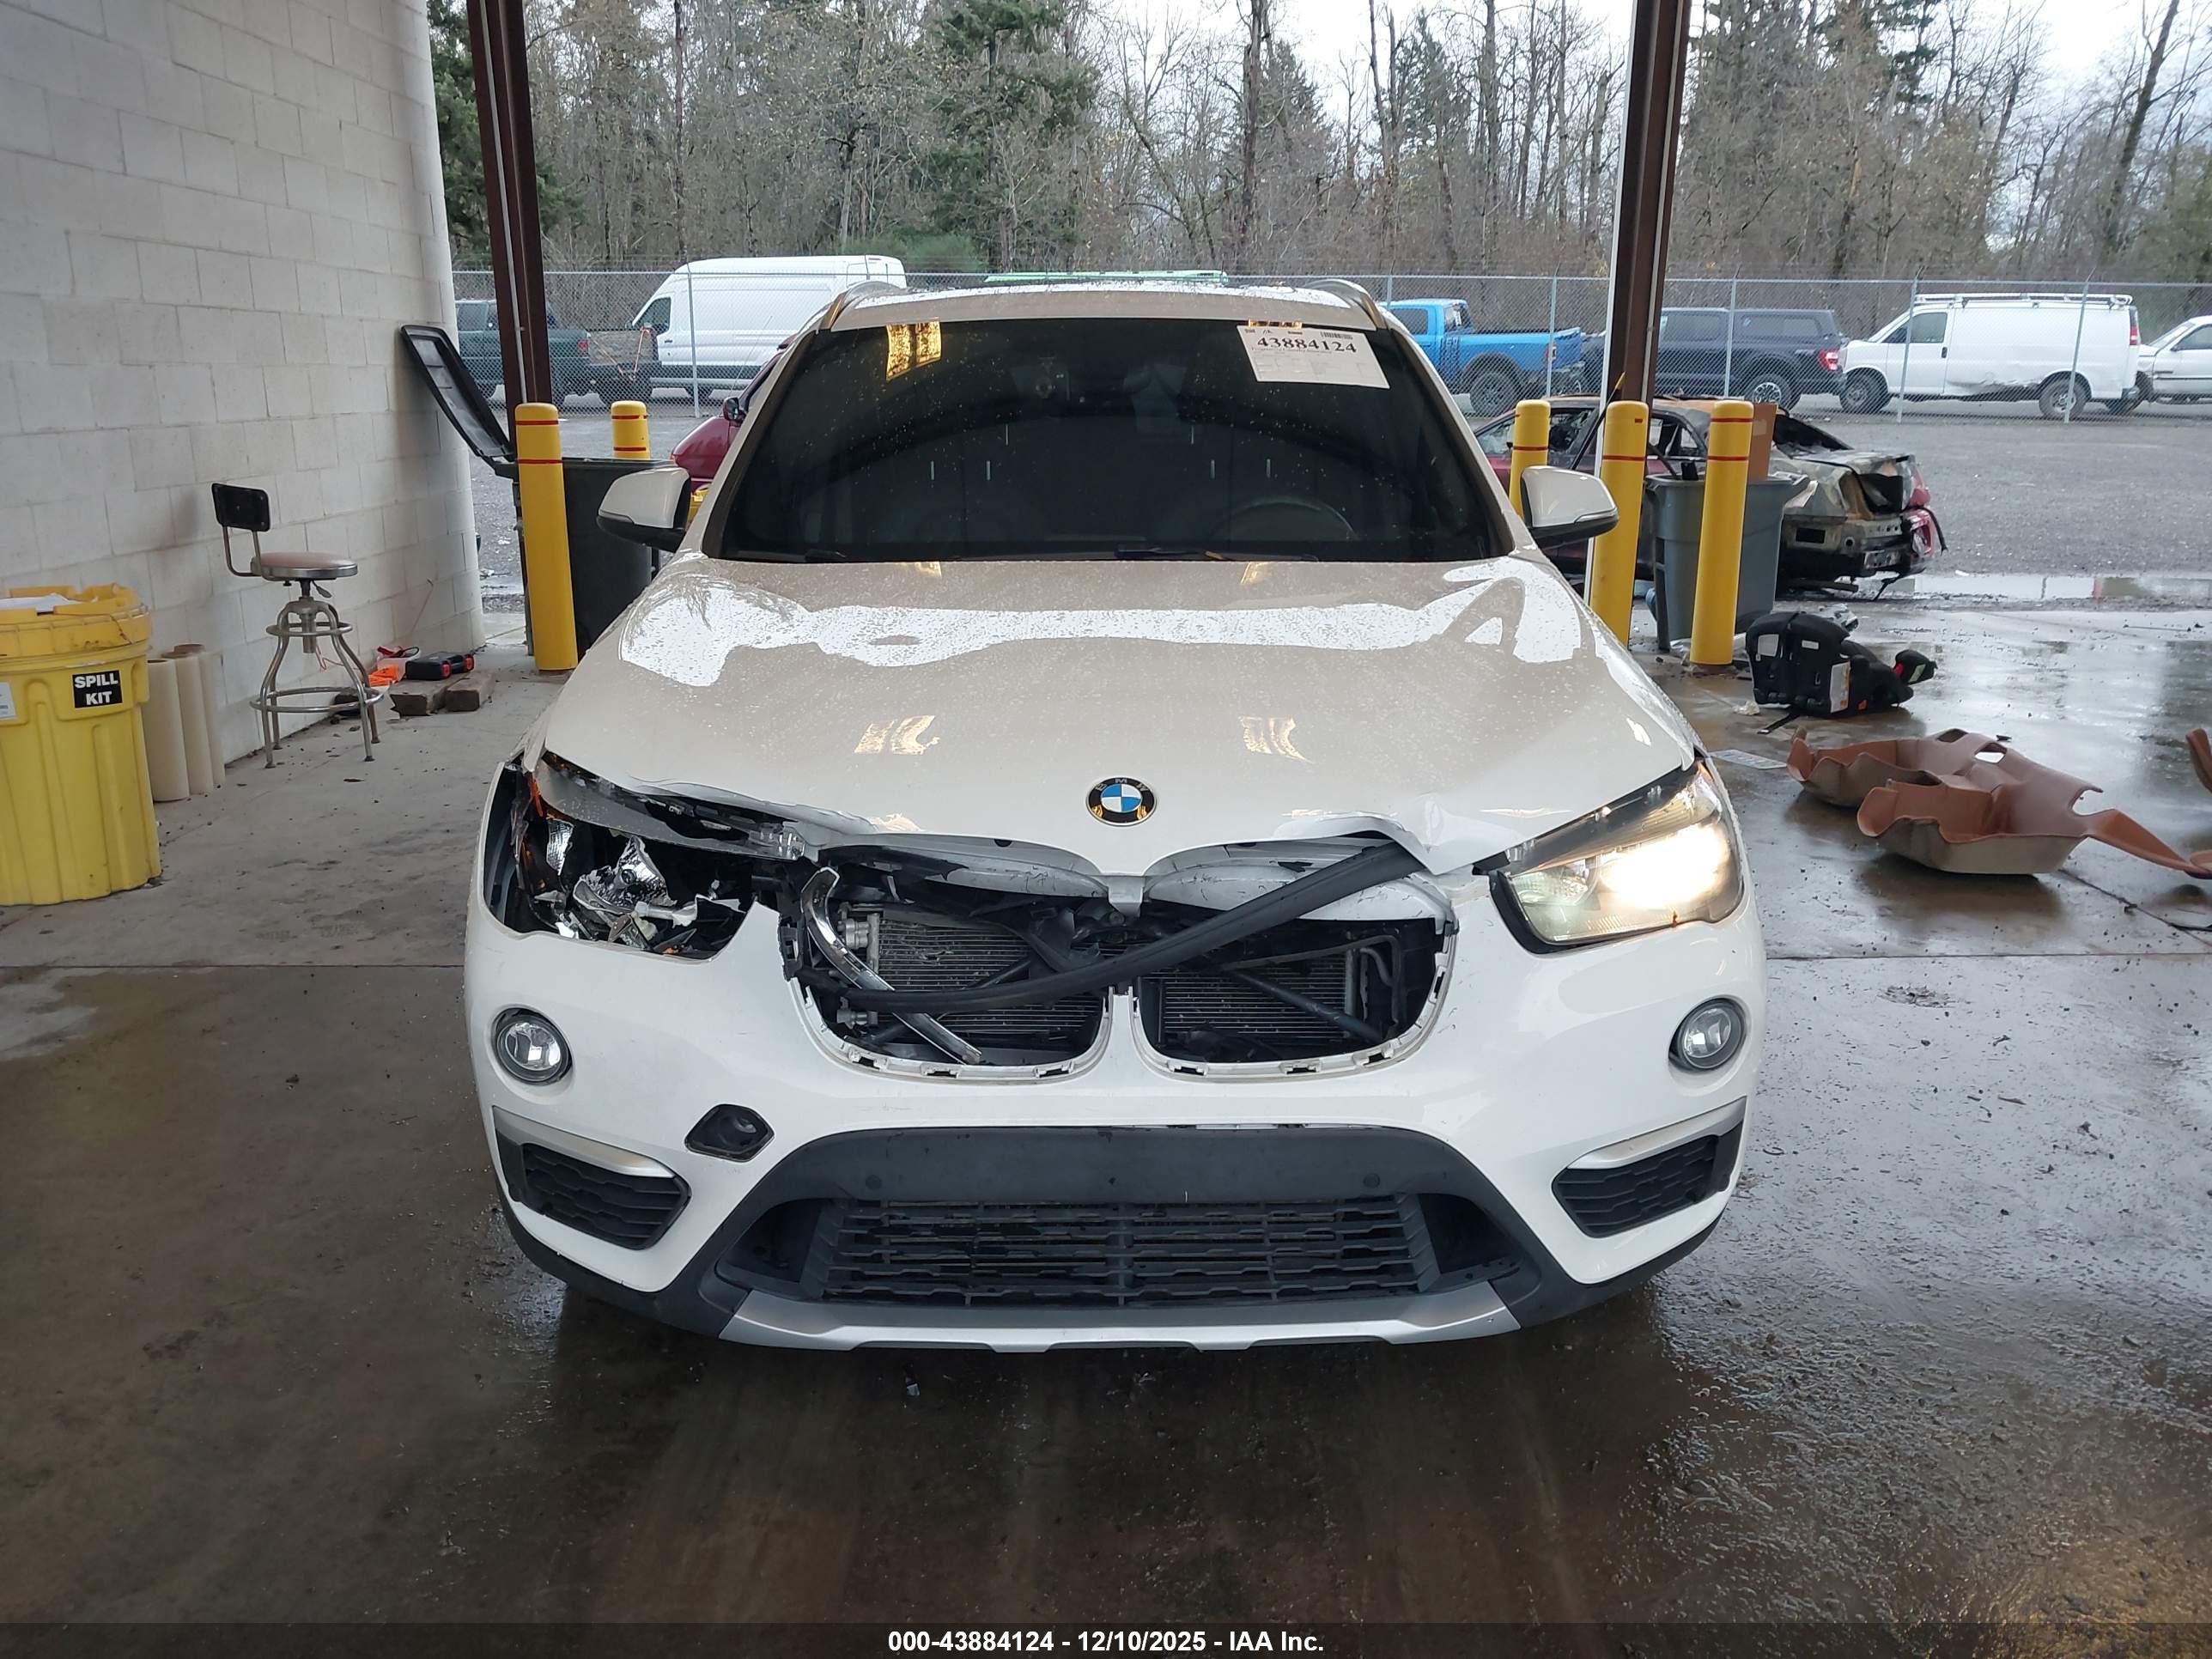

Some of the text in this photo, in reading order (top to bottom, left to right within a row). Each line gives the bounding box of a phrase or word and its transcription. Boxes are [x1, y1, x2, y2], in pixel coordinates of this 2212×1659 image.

[1257, 337, 1357, 353] 43884124
[74, 672, 118, 689] SPILL
[85, 690, 112, 706] KIT
[1094, 778, 1149, 792] BMW
